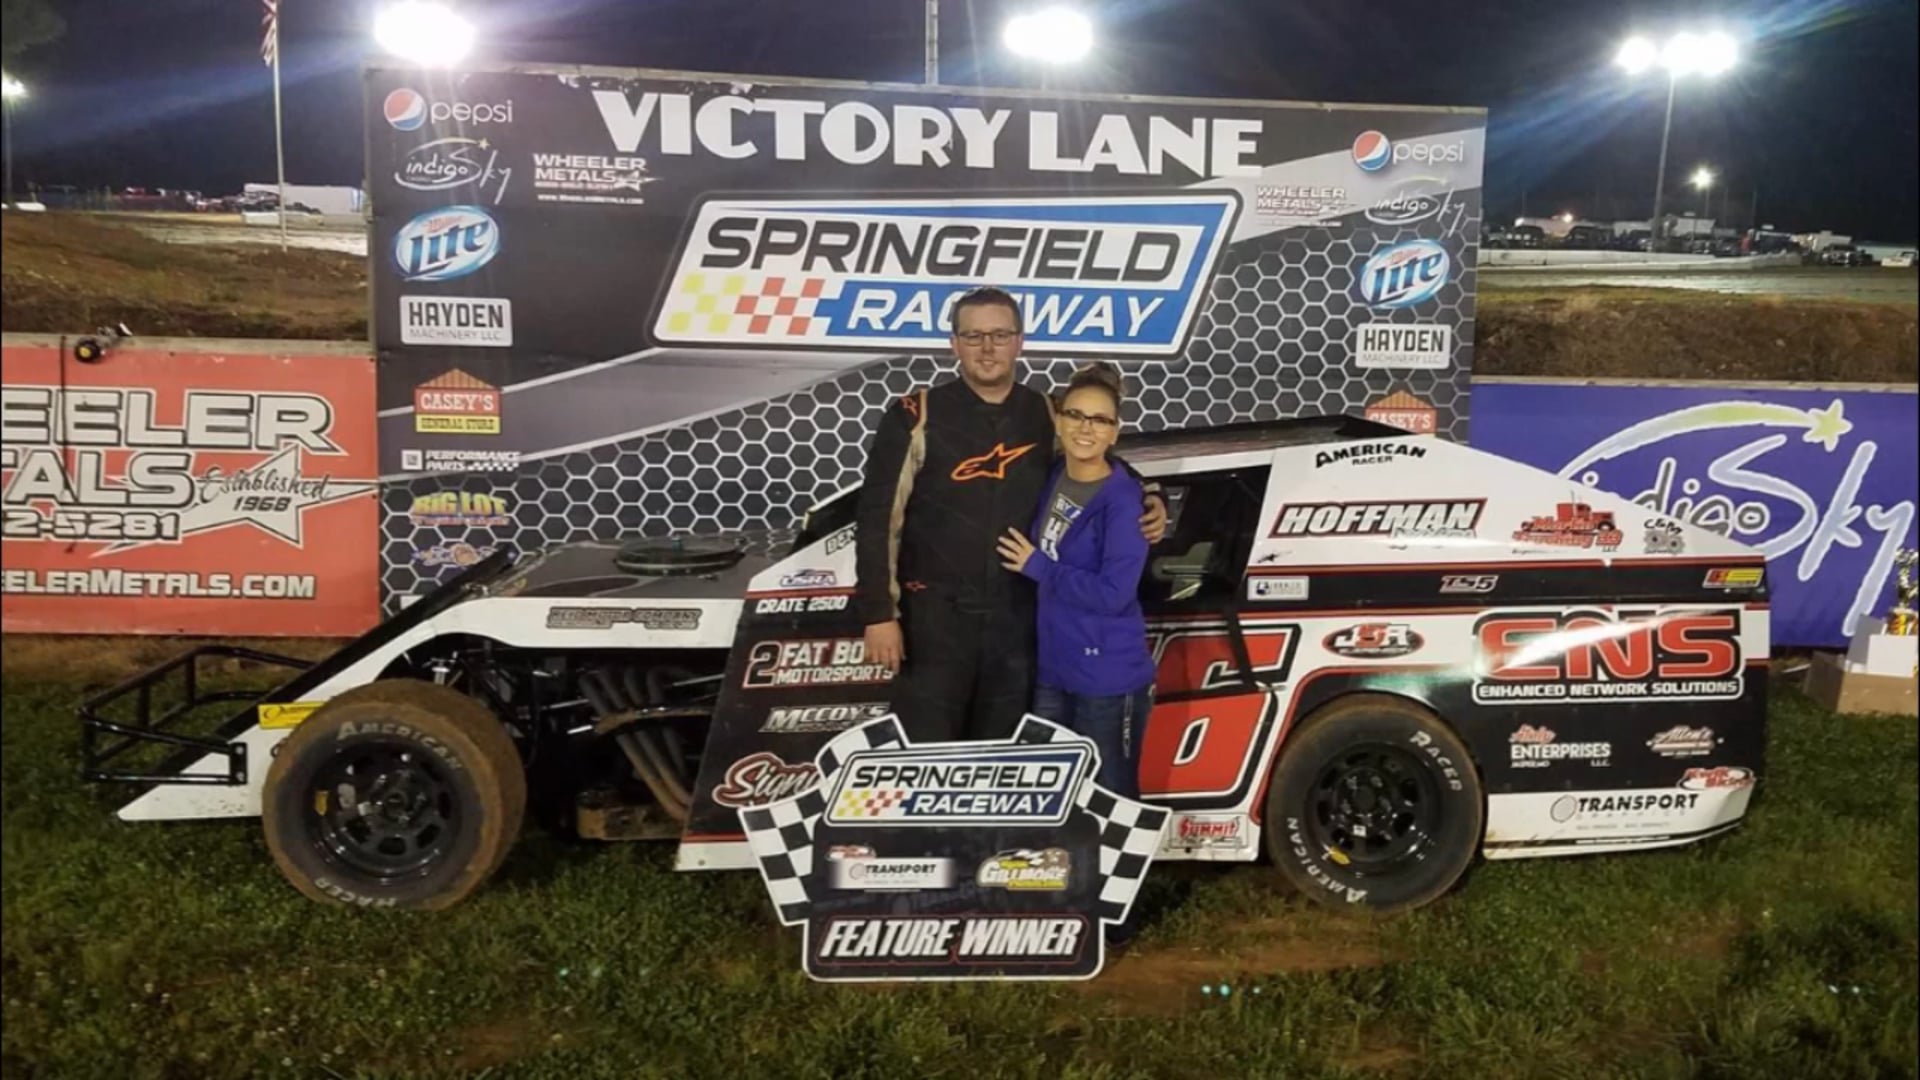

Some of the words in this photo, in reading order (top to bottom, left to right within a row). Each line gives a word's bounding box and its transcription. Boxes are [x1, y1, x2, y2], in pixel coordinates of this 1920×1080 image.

[431, 99, 513, 126] pepsi
[592, 91, 1012, 169] VICTORY
[1027, 110, 1264, 177] LANE
[533, 153, 648, 172] WHEELER
[1392, 140, 1465, 166] pepsi
[405, 152, 469, 184] indigo
[535, 168, 617, 183] METALS
[1256, 187, 1346, 199] WHEELER
[406, 219, 490, 277] Lite
[699, 216, 1181, 283] SPRINGFIELD
[1368, 252, 1443, 305] Lite
[408, 302, 504, 328] HAYDEN
[846, 289, 1164, 339] RACWAY
[409, 328, 477, 340] MACHINERY
[1363, 328, 1444, 352] HAYDEN
[420, 392, 494, 412] CASEY'S
[1315, 443, 1427, 469] AMERICAN
[1351, 455, 1394, 466] RACER
[200, 464, 331, 504] Established
[233, 495, 292, 513] 1968
[1274, 502, 1482, 535] HOFFMAN
[756, 597, 807, 614] CRATE
[807, 595, 849, 612] 2500
[780, 641, 828, 667] FAT
[831, 640, 866, 665] BO
[1478, 612, 1738, 681] ENS
[742, 640, 783, 688] 2
[776, 663, 895, 685] MOTORSPORTS
[1478, 683, 1566, 698] ENHANCED
[1569, 682, 1648, 697] NETWORK
[1651, 680, 1738, 695] SOLUTIONS
[1409, 730, 1463, 793] RACER
[1511, 741, 1612, 760] ENTERPRISES
[851, 765, 1062, 788] SPRINGFIELD
[912, 792, 1054, 814] RACEWAY
[1578, 793, 1699, 813] TRANSPORT
[865, 863, 937, 875] TRANSPORT
[1286, 816, 1369, 904] AMERICAN
[820, 919, 959, 957] FEATURE
[958, 918, 1082, 957] WINNER
